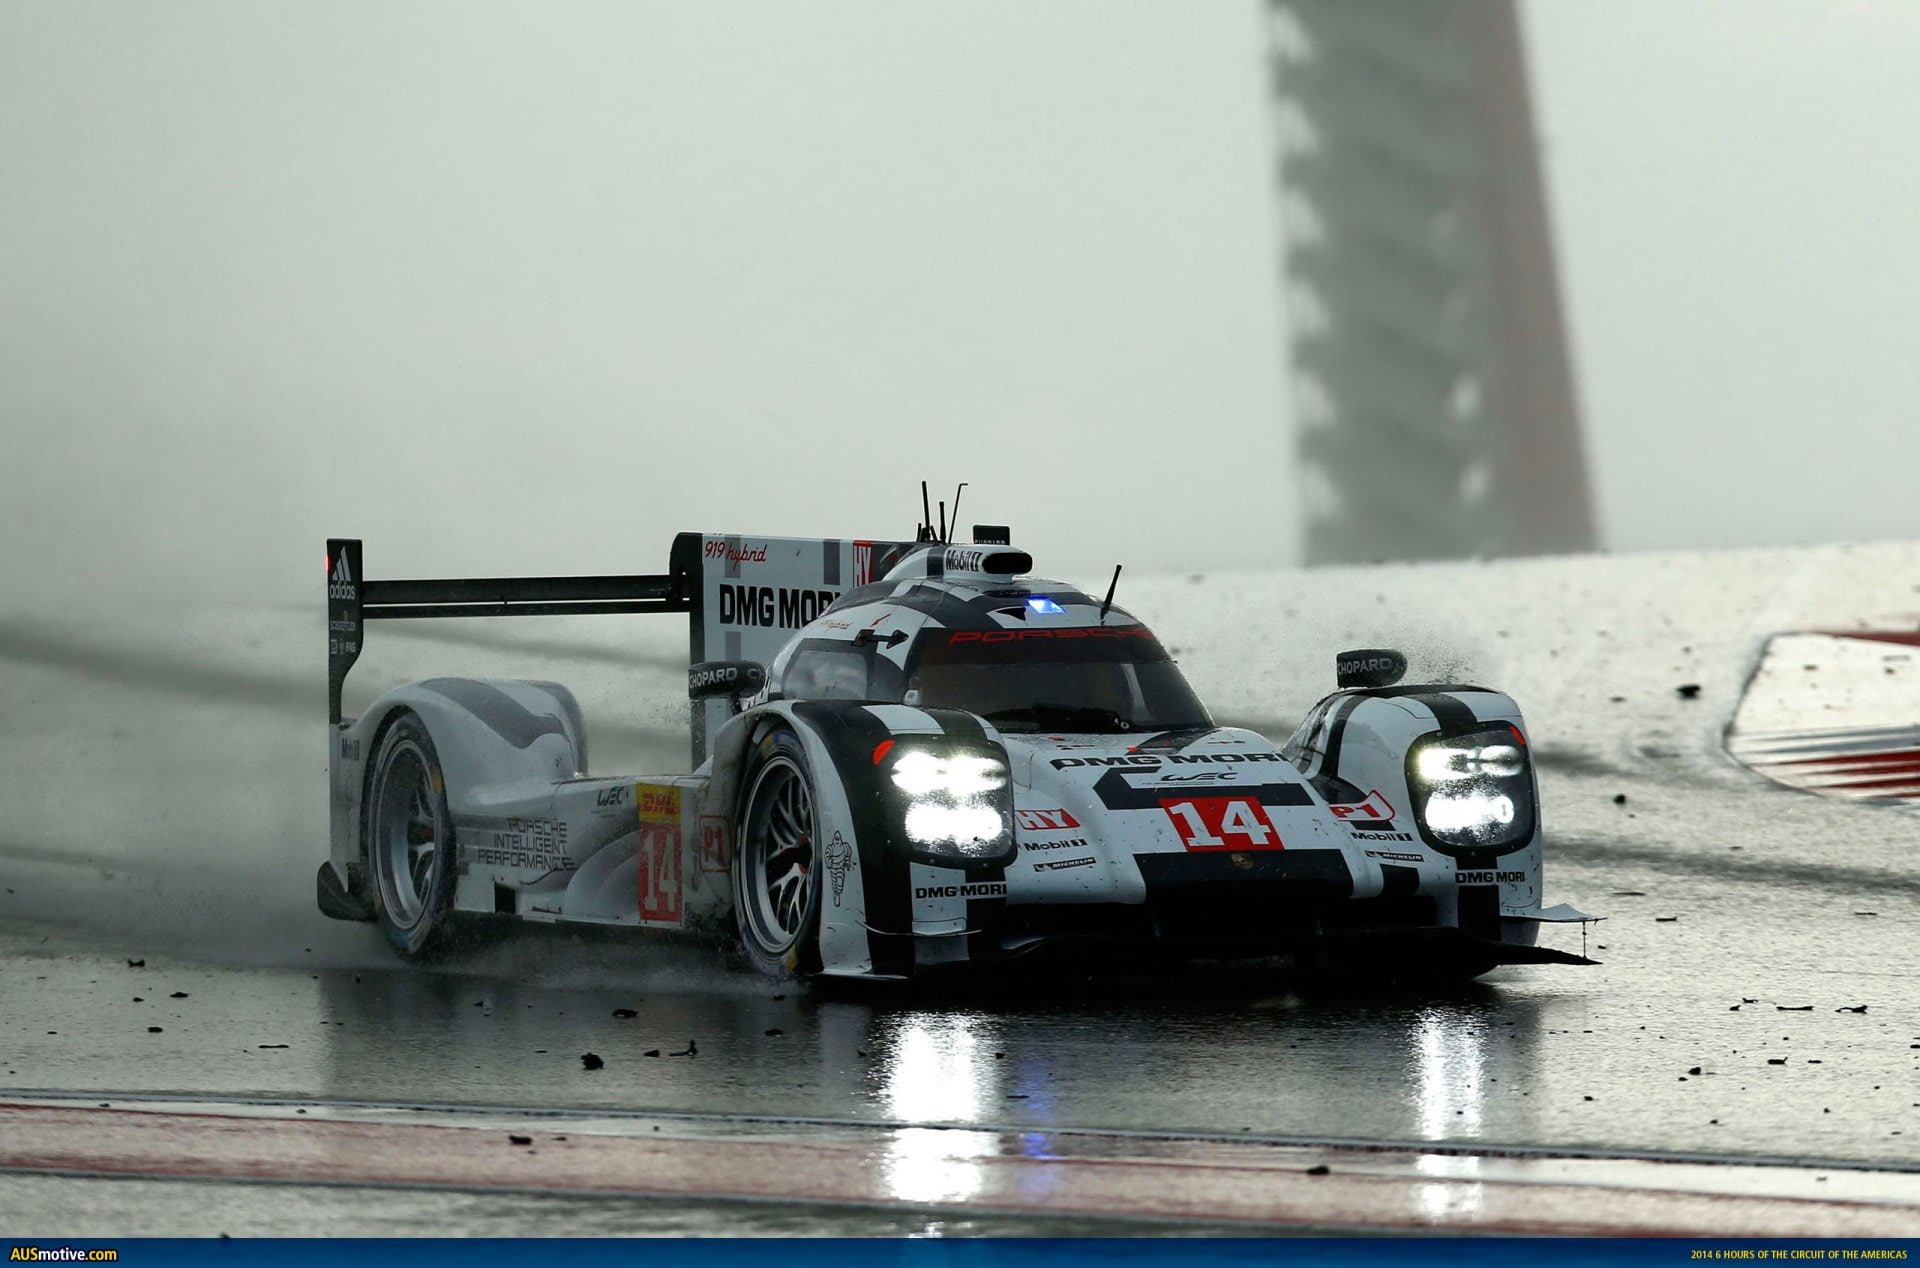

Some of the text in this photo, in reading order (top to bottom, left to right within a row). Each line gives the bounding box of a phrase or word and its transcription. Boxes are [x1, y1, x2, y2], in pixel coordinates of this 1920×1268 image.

[705, 541, 768, 571] 919 hybrid
[329, 581, 356, 599] adidas
[720, 584, 841, 629] DMG MOR
[1338, 658, 1392, 675] CHOPARD
[689, 667, 737, 688] CHOPARD
[1050, 754, 1289, 770] DMG MORI
[1161, 772, 1238, 782] WEC
[597, 786, 625, 807] WEC
[1015, 811, 1068, 829] HY
[1329, 804, 1381, 818] P1
[508, 817, 567, 838] PORSCHE
[1169, 801, 1271, 846] 14
[494, 833, 567, 855] INTELLIGENT
[704, 825, 725, 864] P1
[1024, 840, 1070, 851] Mobil
[1351, 832, 1397, 841] Mobil
[478, 849, 576, 872] PERFORMANCE
[1051, 858, 1094, 869] MICHELIN
[1382, 853, 1422, 861] MICHELIN
[644, 830, 677, 912] 14
[1456, 871, 1525, 883] DMG MORI
[916, 883, 1007, 898] DMG MORI
